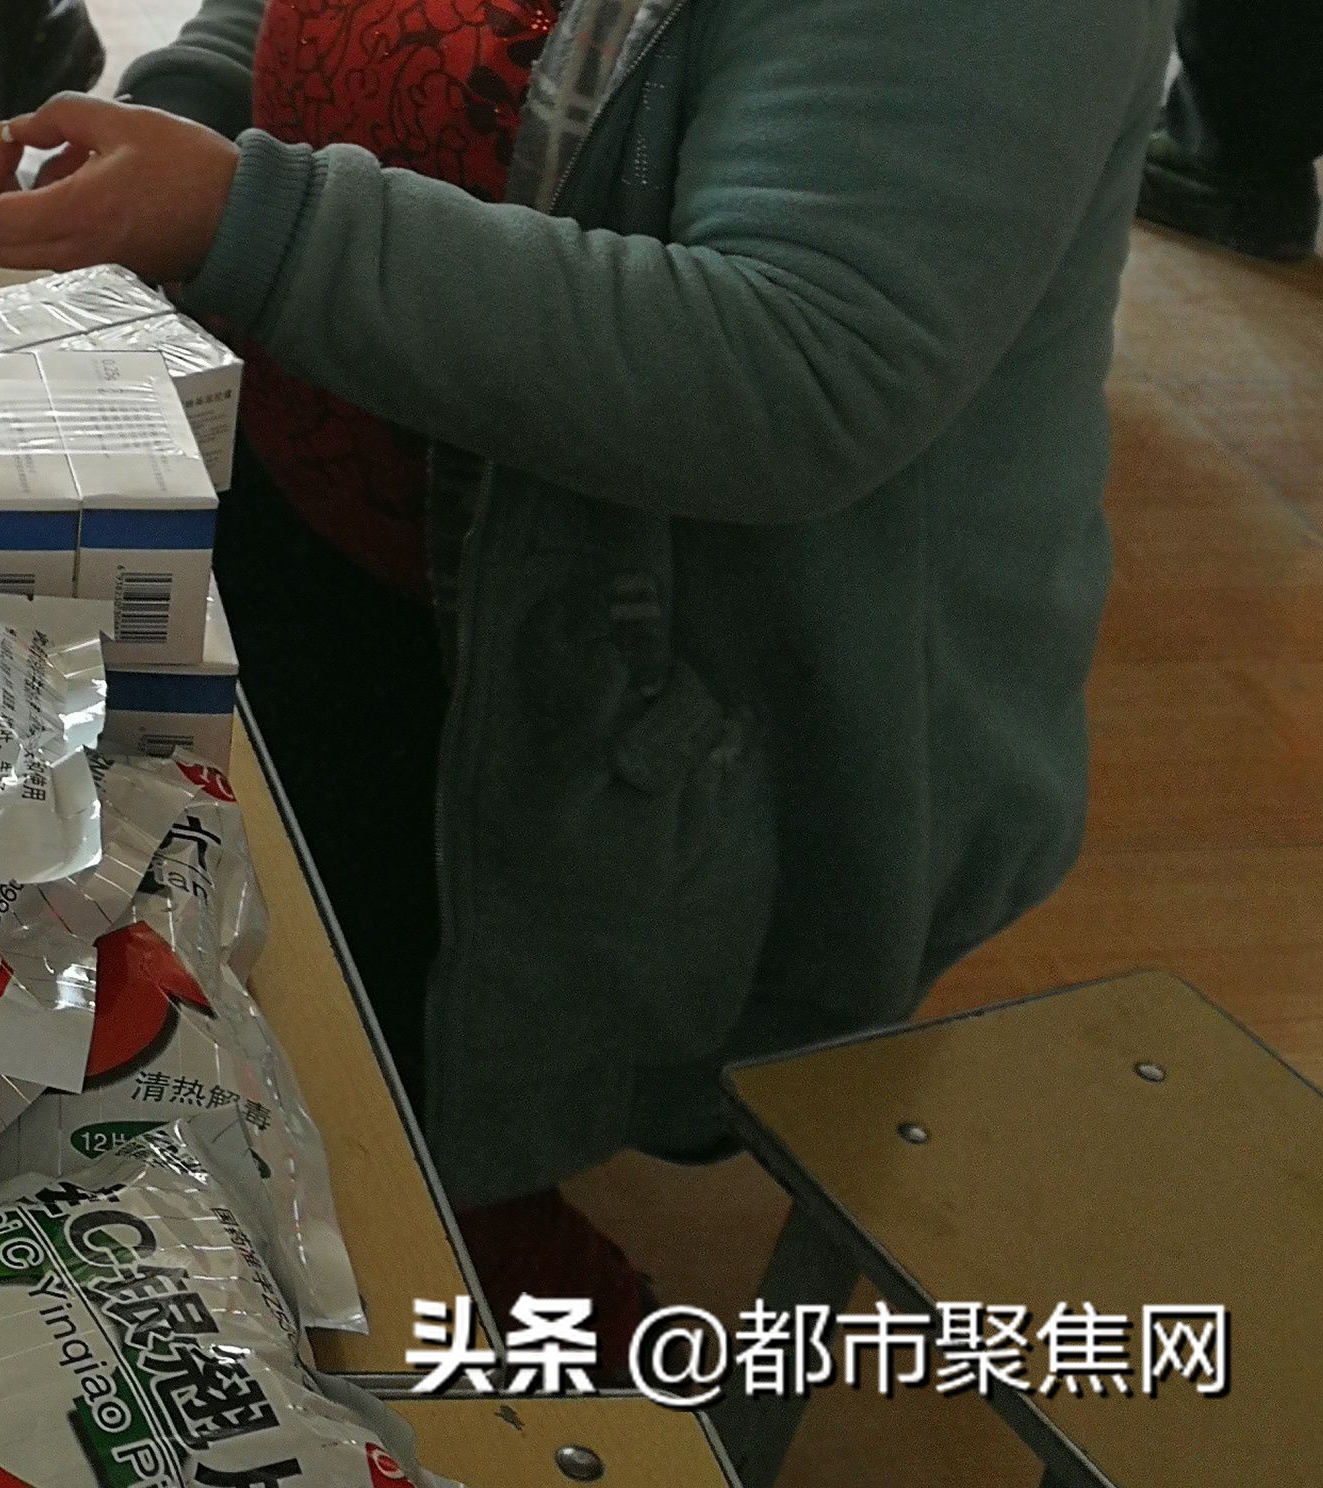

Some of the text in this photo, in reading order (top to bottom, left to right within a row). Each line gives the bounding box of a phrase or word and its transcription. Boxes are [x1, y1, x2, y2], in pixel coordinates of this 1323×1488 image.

[131, 1071, 273, 1131] 清热解毒
[28, 1271, 132, 1434] Yinqiao
